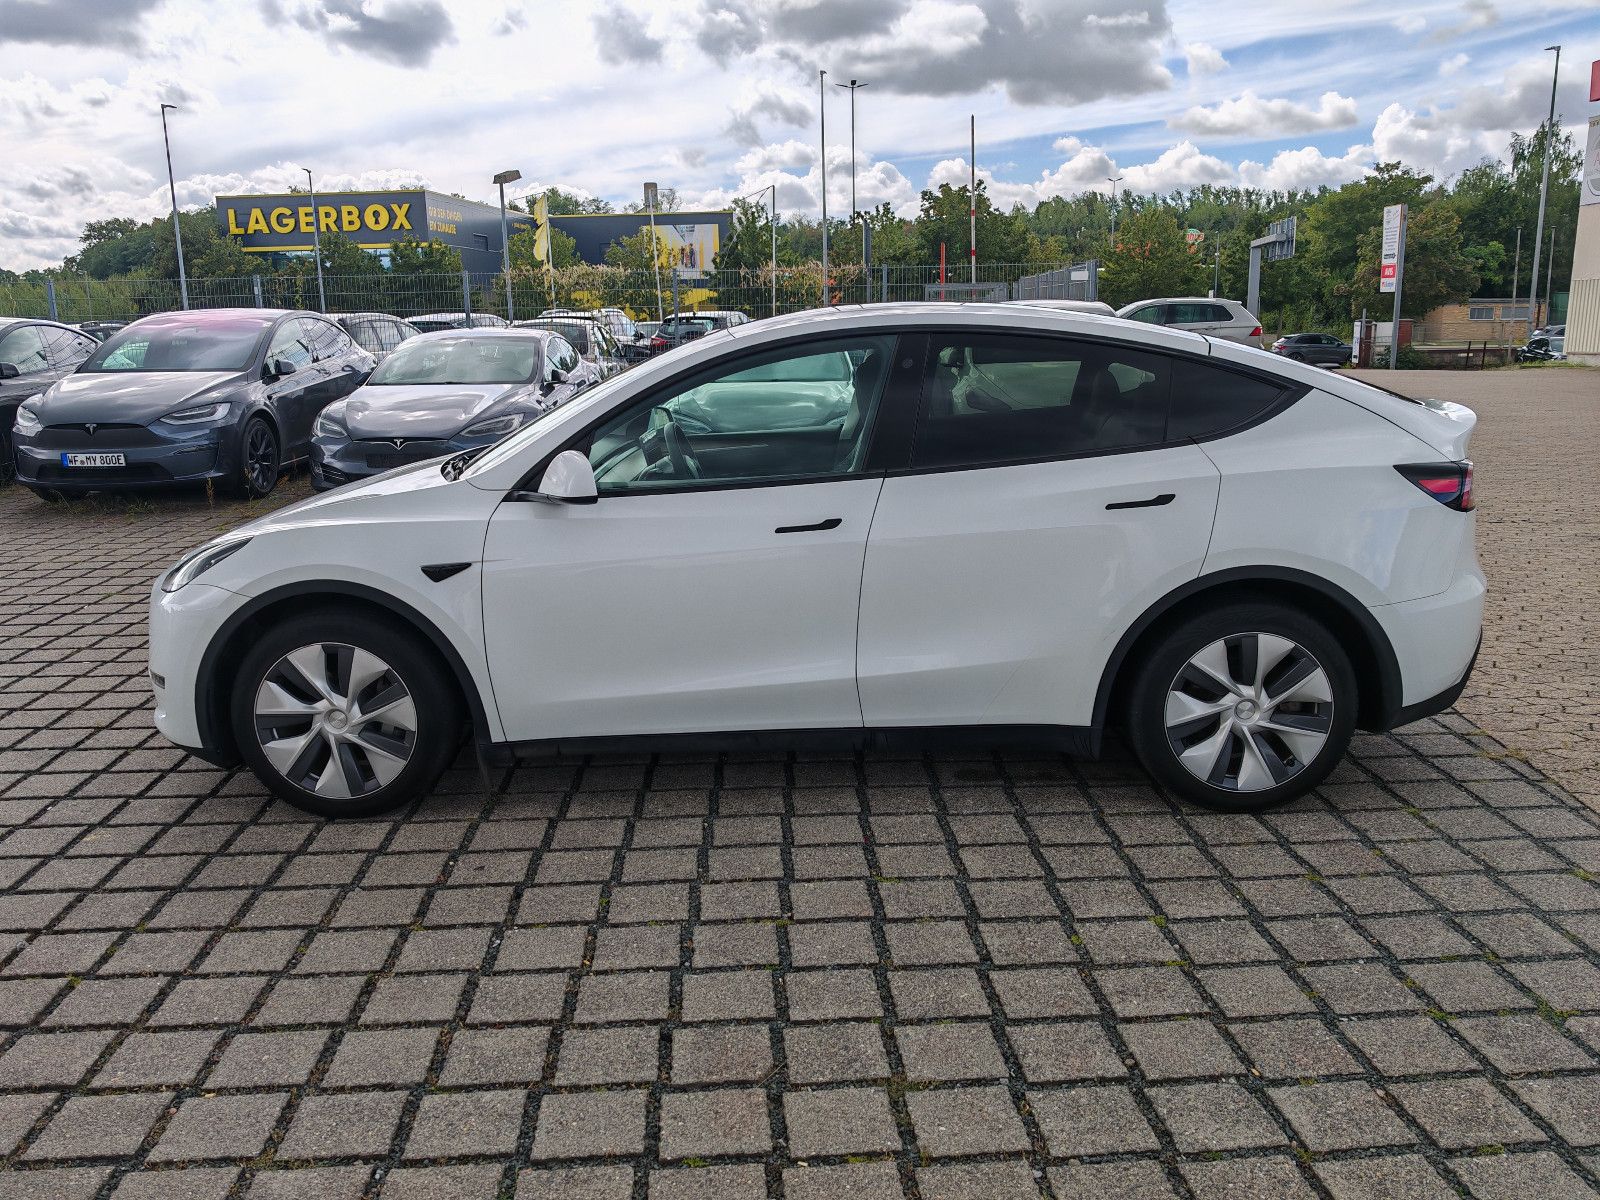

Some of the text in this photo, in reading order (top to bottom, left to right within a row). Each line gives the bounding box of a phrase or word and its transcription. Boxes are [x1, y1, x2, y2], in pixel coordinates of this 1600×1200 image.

[227, 203, 413, 235] LAGERBOX
[85, 455, 97, 465] MY
[99, 455, 124, 465] 800E
